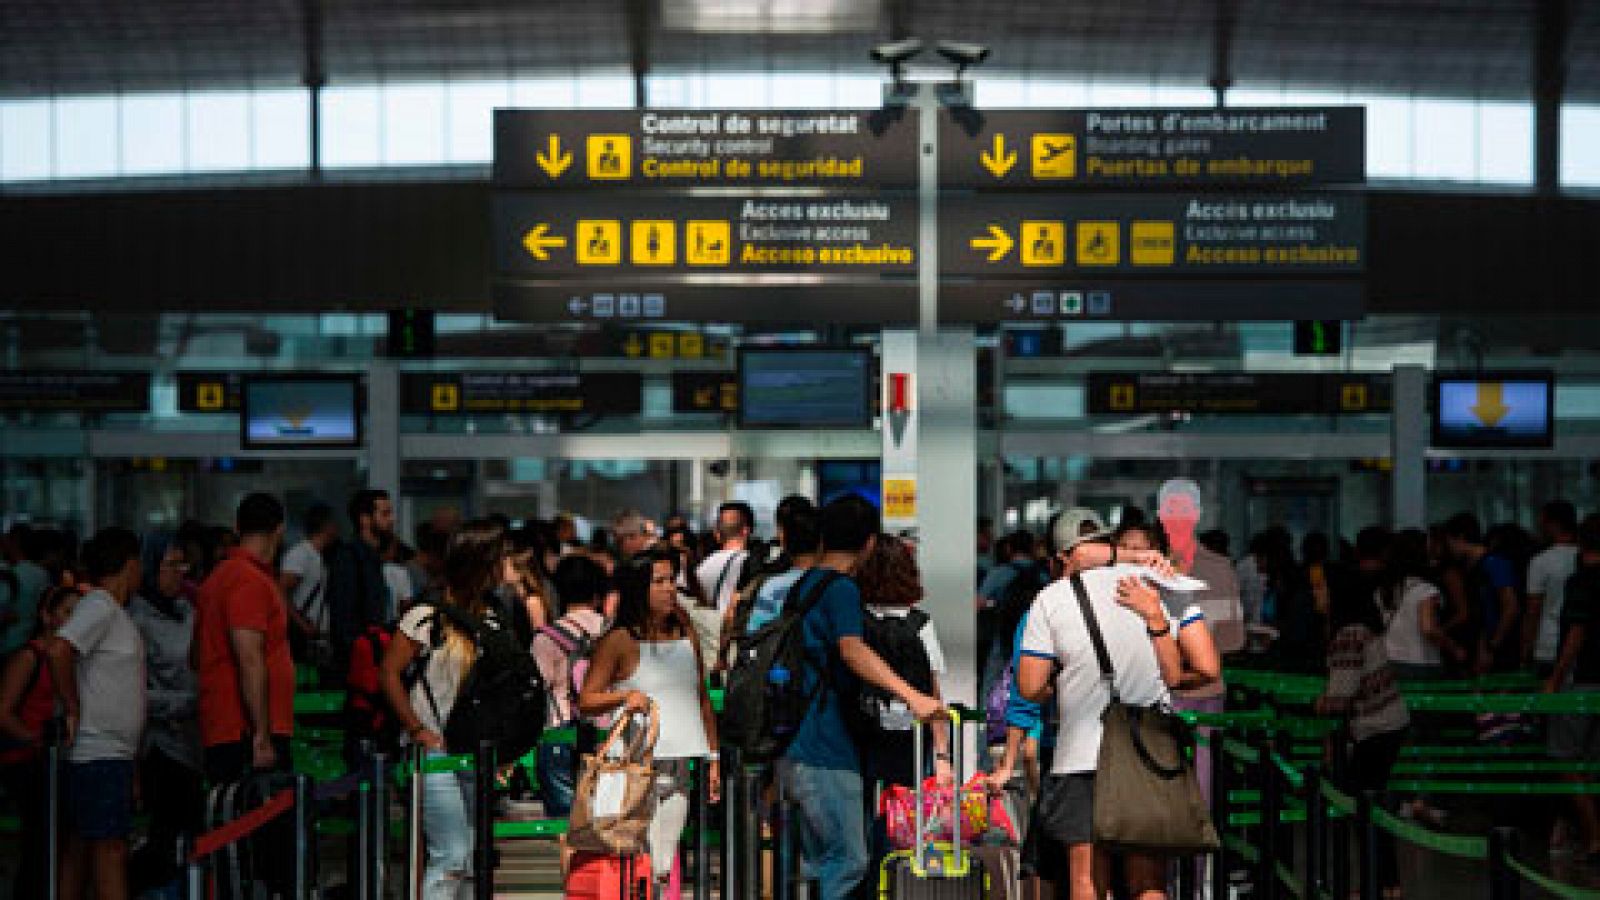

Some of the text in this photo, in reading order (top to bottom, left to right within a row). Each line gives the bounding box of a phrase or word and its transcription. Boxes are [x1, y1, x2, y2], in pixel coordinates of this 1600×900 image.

[641, 114, 718, 133] Control
[724, 114, 750, 133] de
[1087, 112, 1327, 133] Portes d'embarcament
[714, 138, 772, 154] control
[642, 156, 863, 179] Control de seguridad
[1086, 156, 1313, 179] Puertas de embarque
[807, 200, 890, 220] exclusiu
[1252, 199, 1335, 219] exclusiu
[741, 244, 914, 264] Acceso exclusivo
[1186, 244, 1260, 263] Acceso
[1265, 243, 1359, 264] exclusivo
